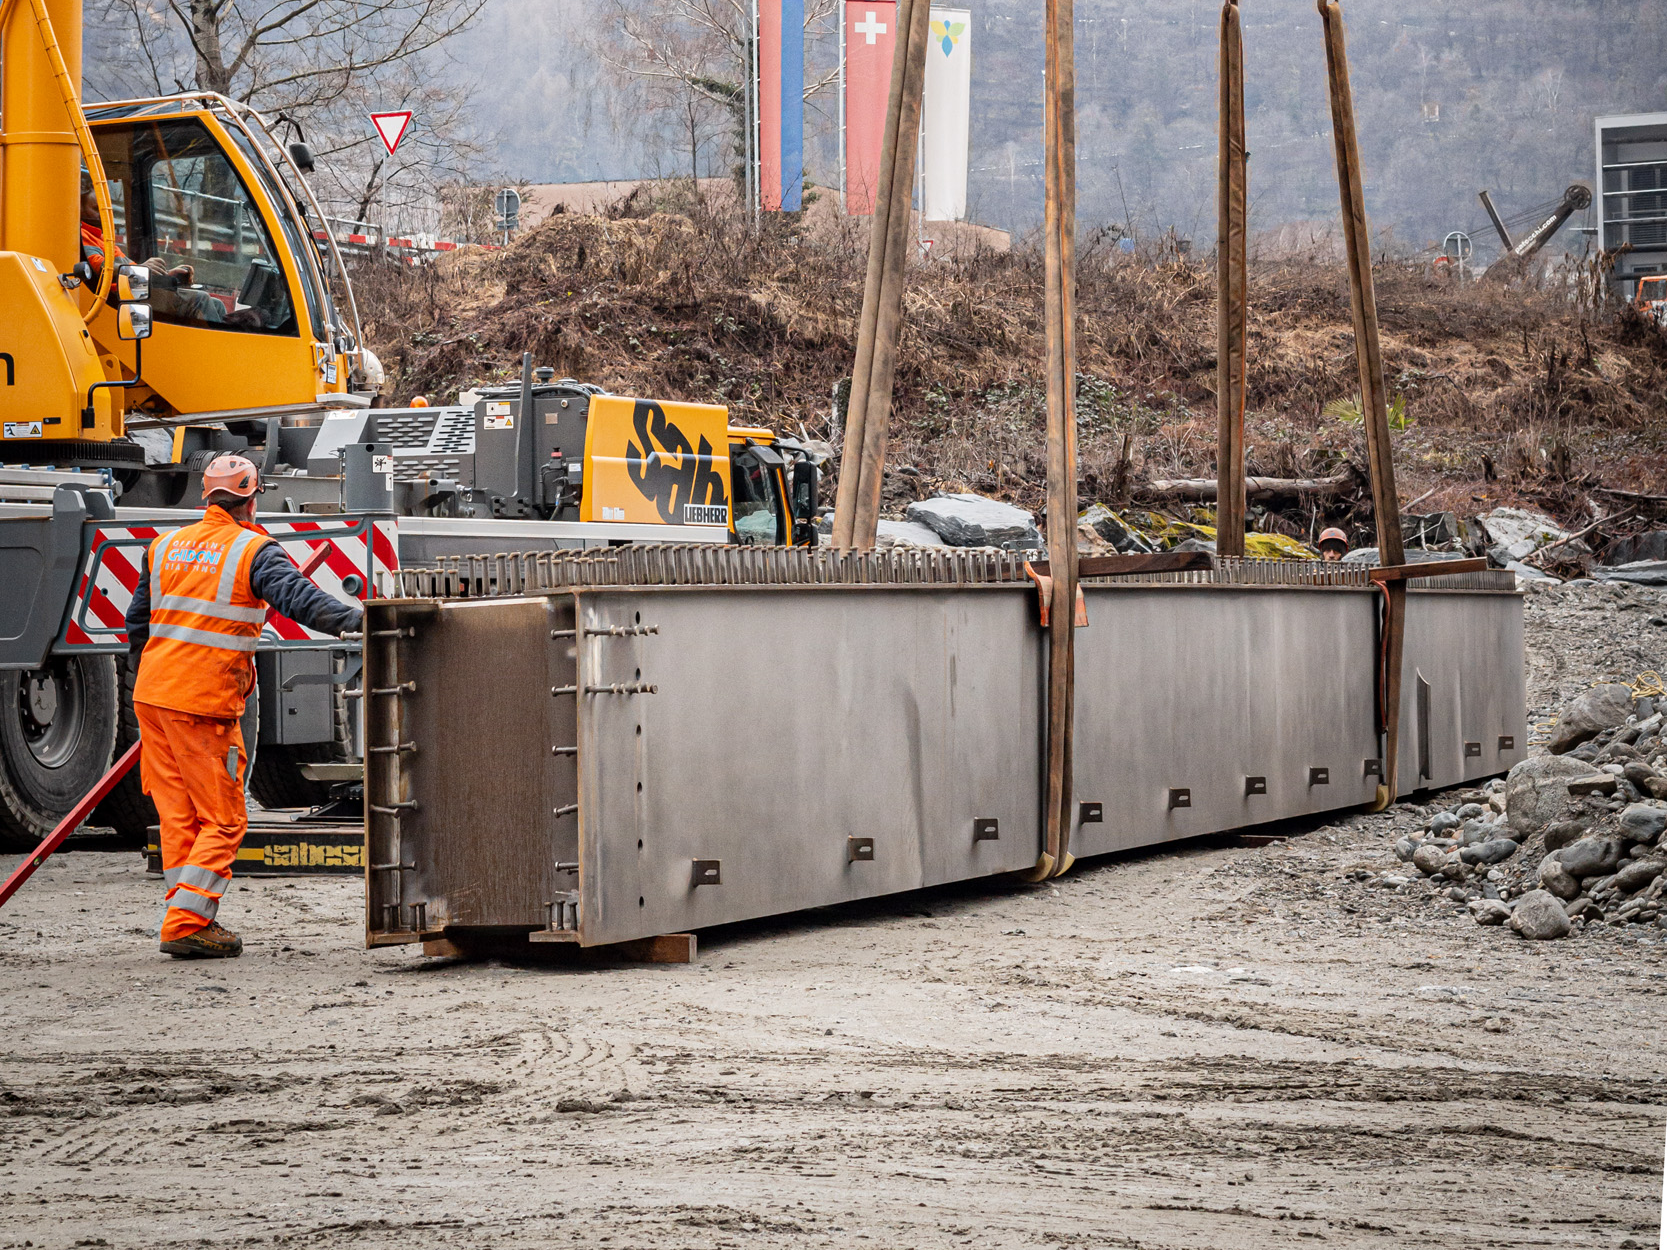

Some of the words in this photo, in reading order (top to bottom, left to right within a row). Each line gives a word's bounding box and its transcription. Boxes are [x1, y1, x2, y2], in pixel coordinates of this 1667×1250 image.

[1515, 215, 1557, 255] patocchi.com
[684, 505, 728, 525] LIEBHERR
[168, 549, 222, 565] GHIDONI
